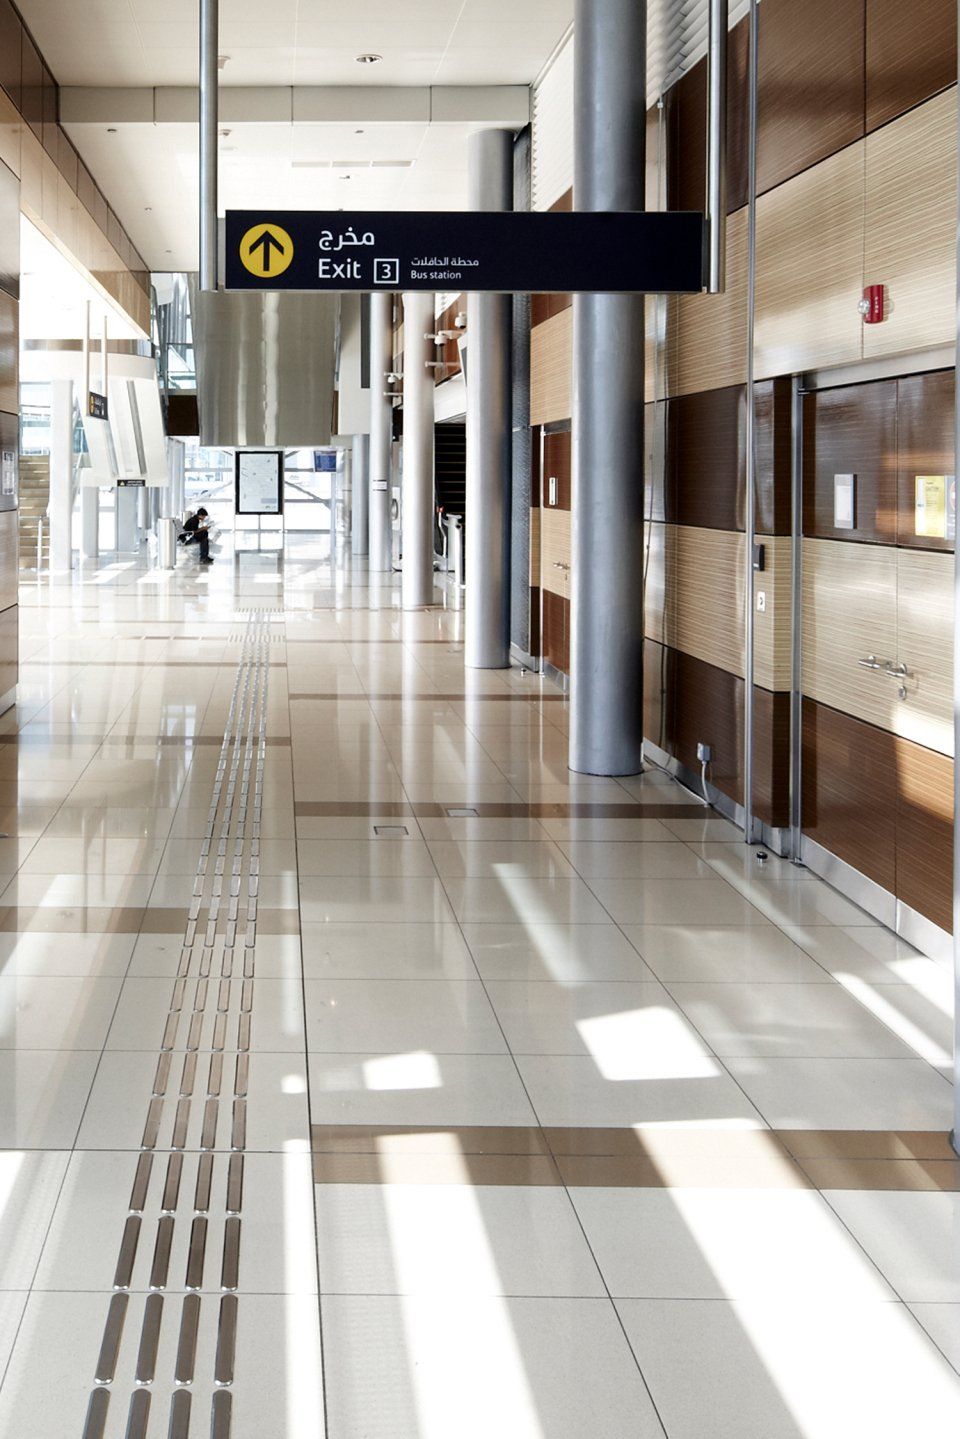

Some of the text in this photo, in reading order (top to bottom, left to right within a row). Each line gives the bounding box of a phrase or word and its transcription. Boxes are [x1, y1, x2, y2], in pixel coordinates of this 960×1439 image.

[319, 226, 375, 251] مخرج
[318, 258, 392, 279] Exit 3
[410, 256, 480, 267] محطة الحافلات
[410, 269, 462, 280] Bus station
